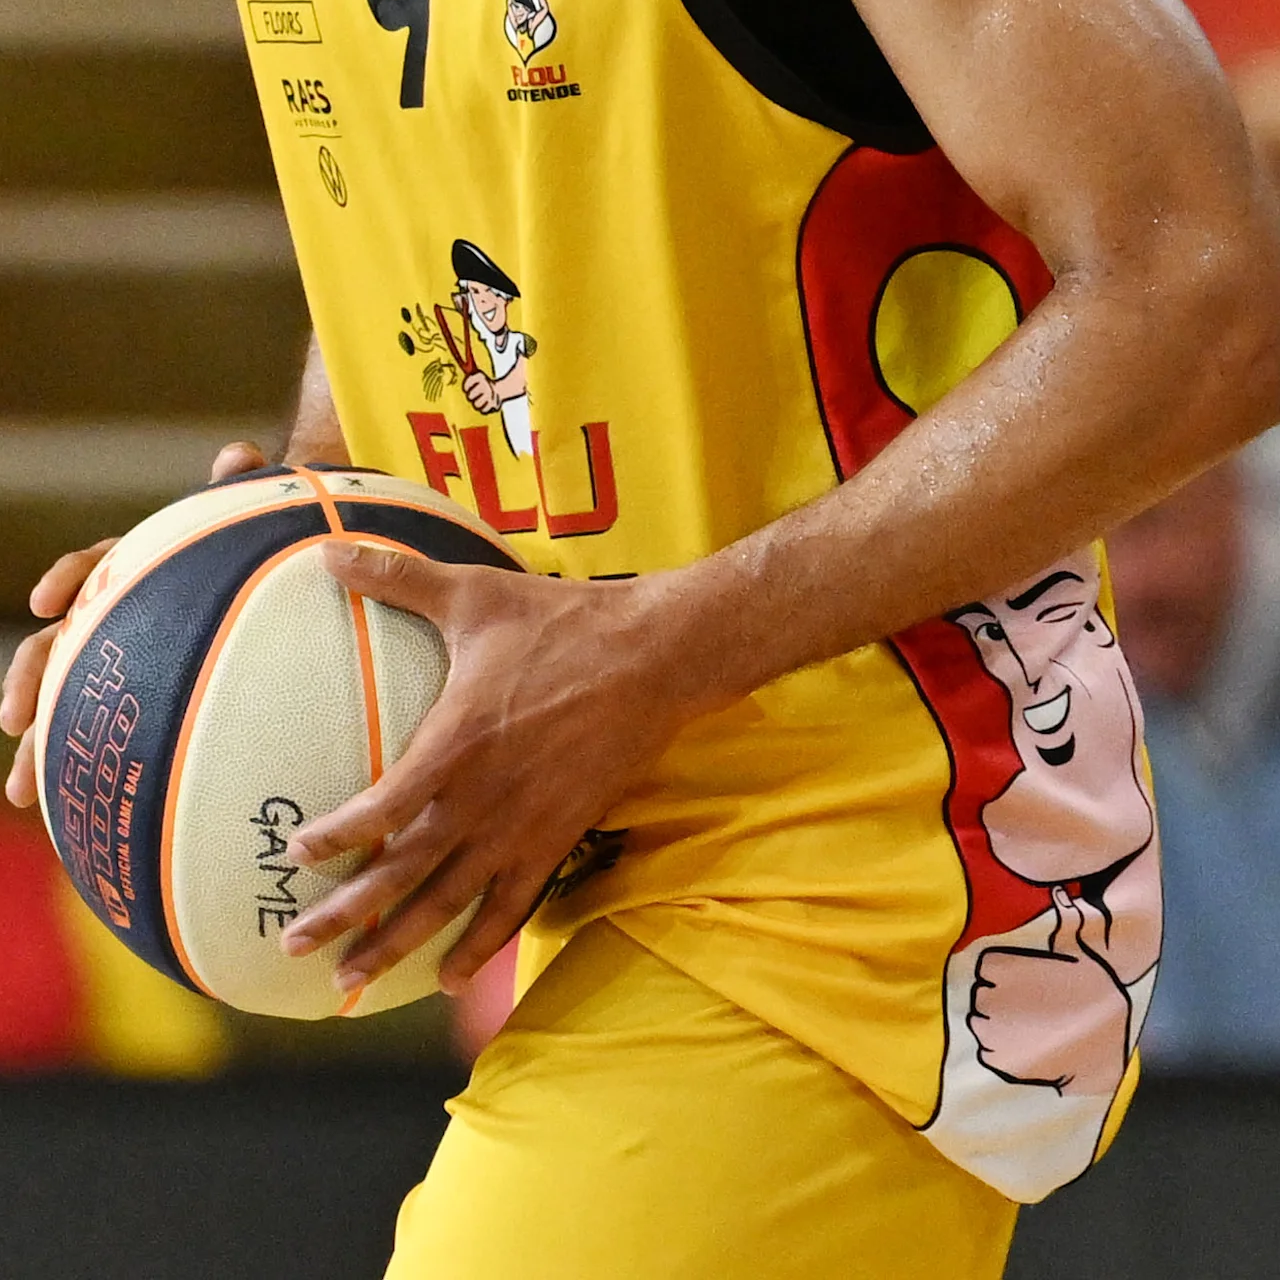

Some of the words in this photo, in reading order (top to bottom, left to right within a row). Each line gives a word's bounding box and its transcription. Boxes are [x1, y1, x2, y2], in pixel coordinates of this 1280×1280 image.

[511, 64, 566, 87] FLOU
[281, 79, 332, 114] RAES
[124, 760, 143, 796] BALL
[117, 796, 134, 838] GAME
[117, 842, 136, 901] OFFICIAL
[249, 796, 304, 938] GAME
